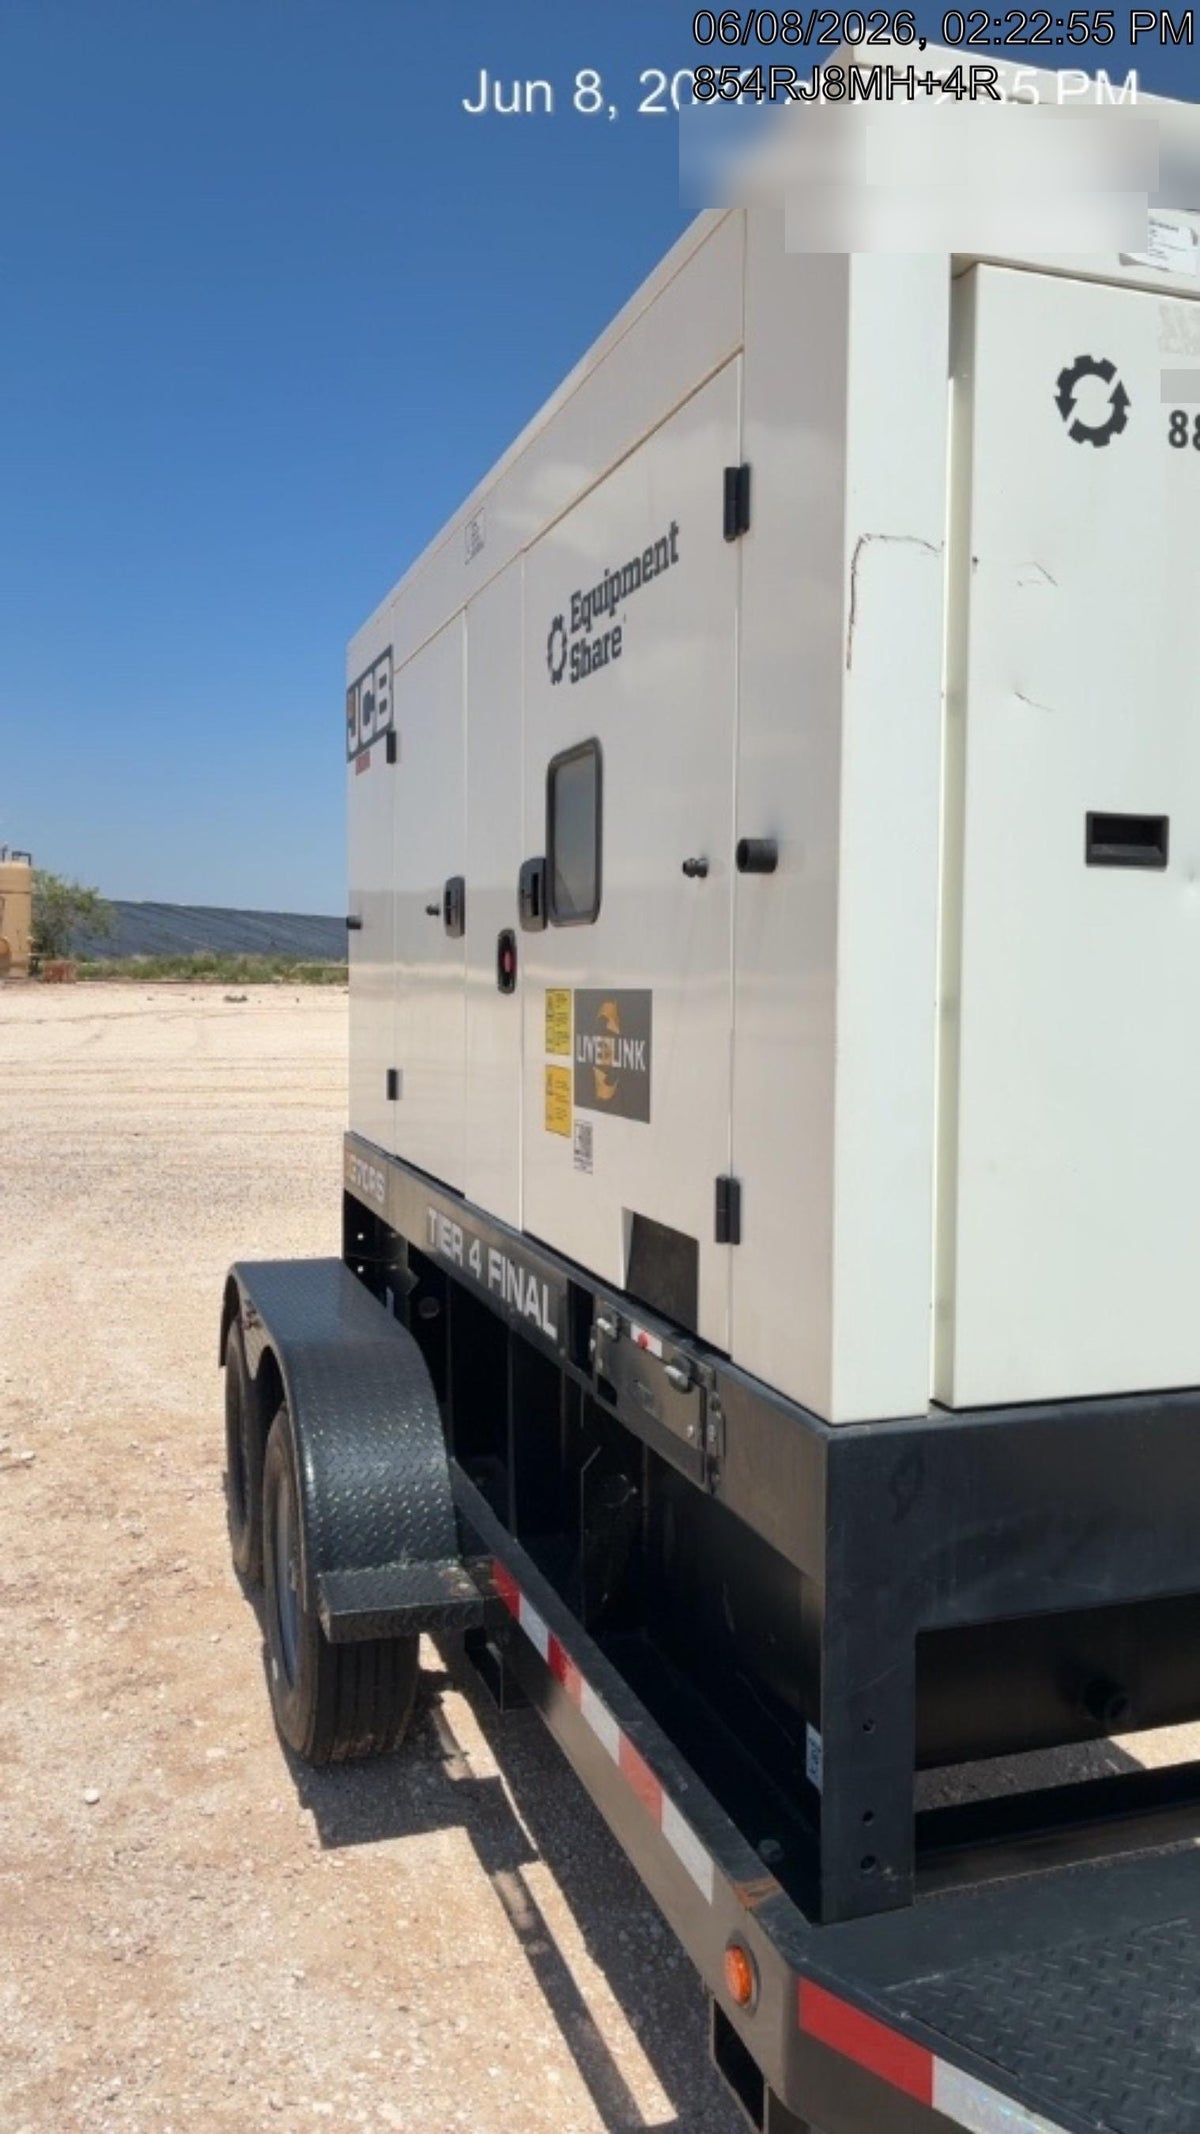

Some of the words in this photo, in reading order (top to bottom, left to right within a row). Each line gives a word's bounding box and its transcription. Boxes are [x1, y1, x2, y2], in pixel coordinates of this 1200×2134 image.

[569, 520, 680, 635] Equipment
[347, 646, 393, 761] JCB
[569, 624, 623, 685] Share
[427, 1206, 464, 1268] TIER
[468, 1238, 483, 1280] 4
[487, 1247, 558, 1341] FINAL
